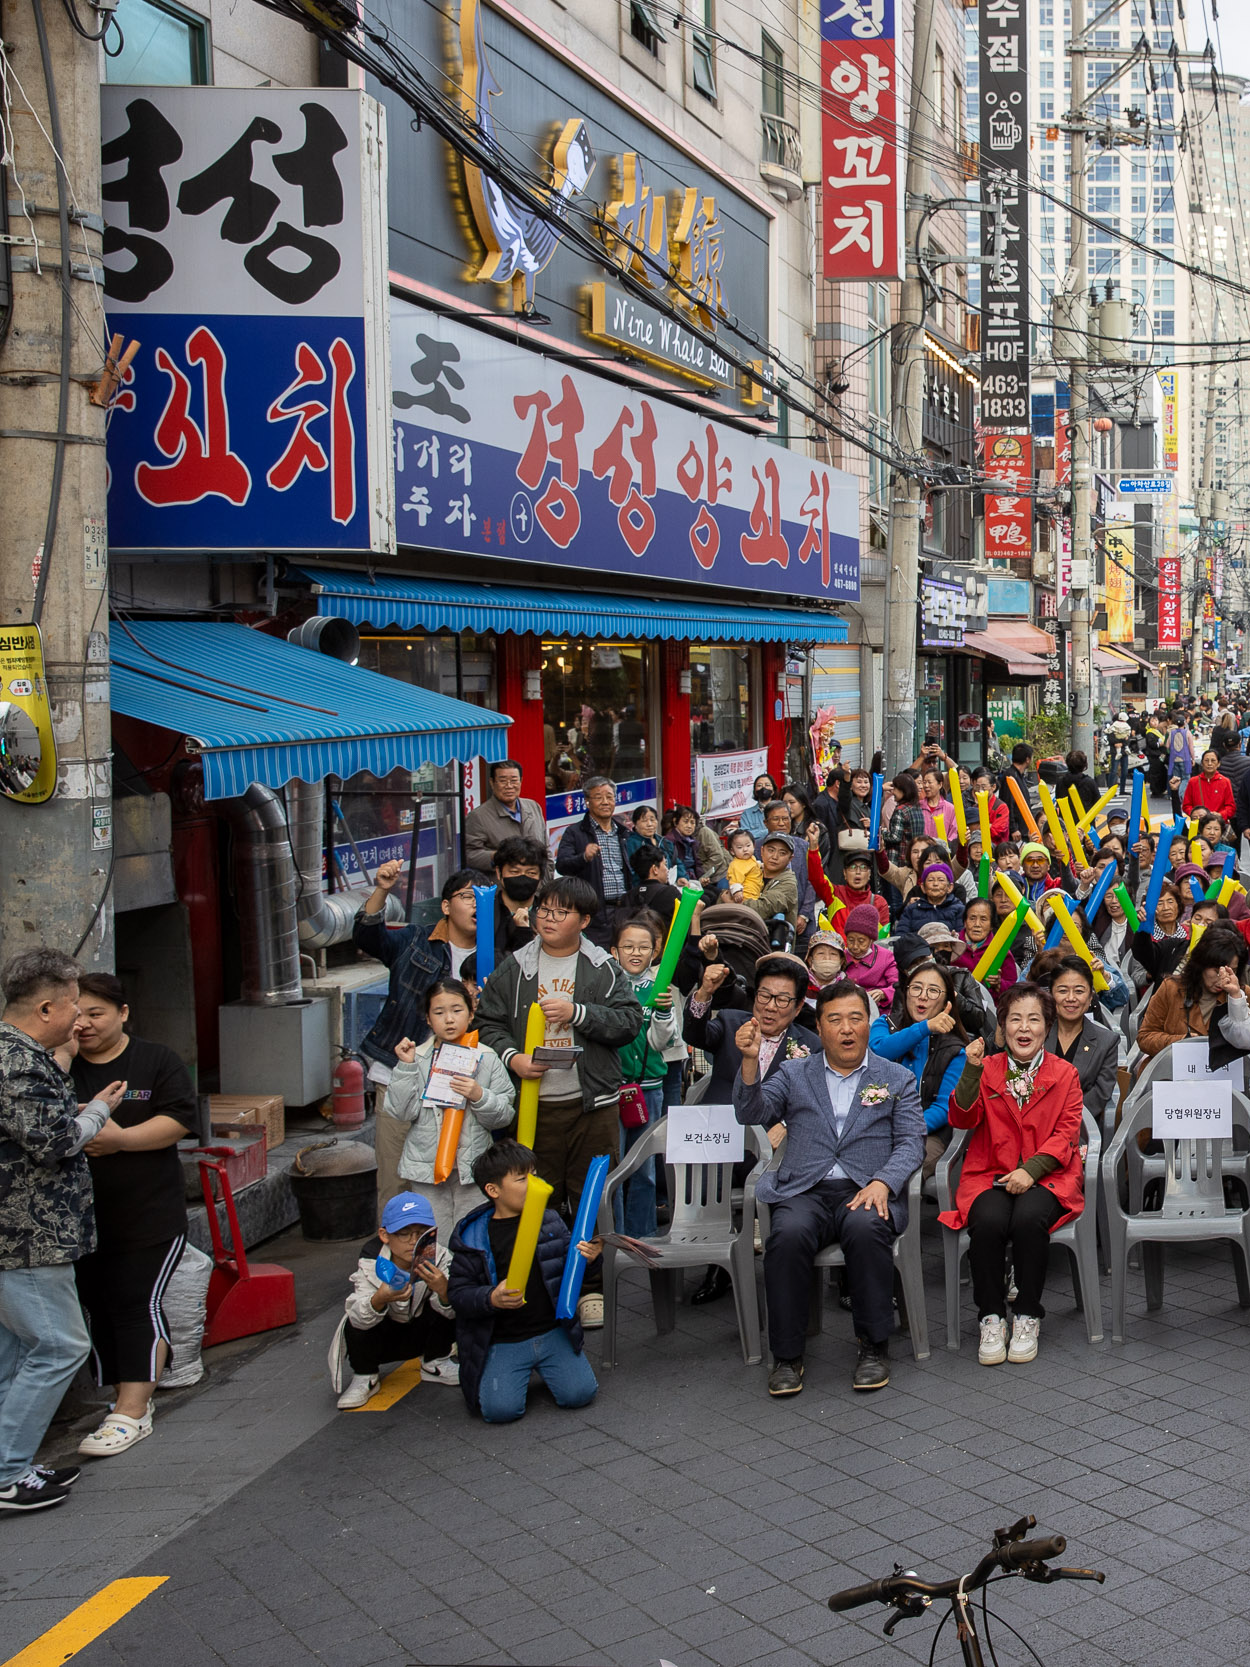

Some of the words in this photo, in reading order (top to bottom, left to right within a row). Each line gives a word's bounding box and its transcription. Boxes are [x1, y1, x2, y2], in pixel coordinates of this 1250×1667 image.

[828, 53, 891, 268] 양꼬치
[613, 298, 654, 345] Nine
[659, 318, 704, 367] Whale
[709, 349, 732, 378] Bar
[986, 341, 1025, 364] HOF
[982, 375, 1028, 394] 463-
[983, 398, 1026, 417] 1833
[1163, 1106, 1222, 1121] 당협위원장님
[683, 1131, 731, 1145] 보건소장님
